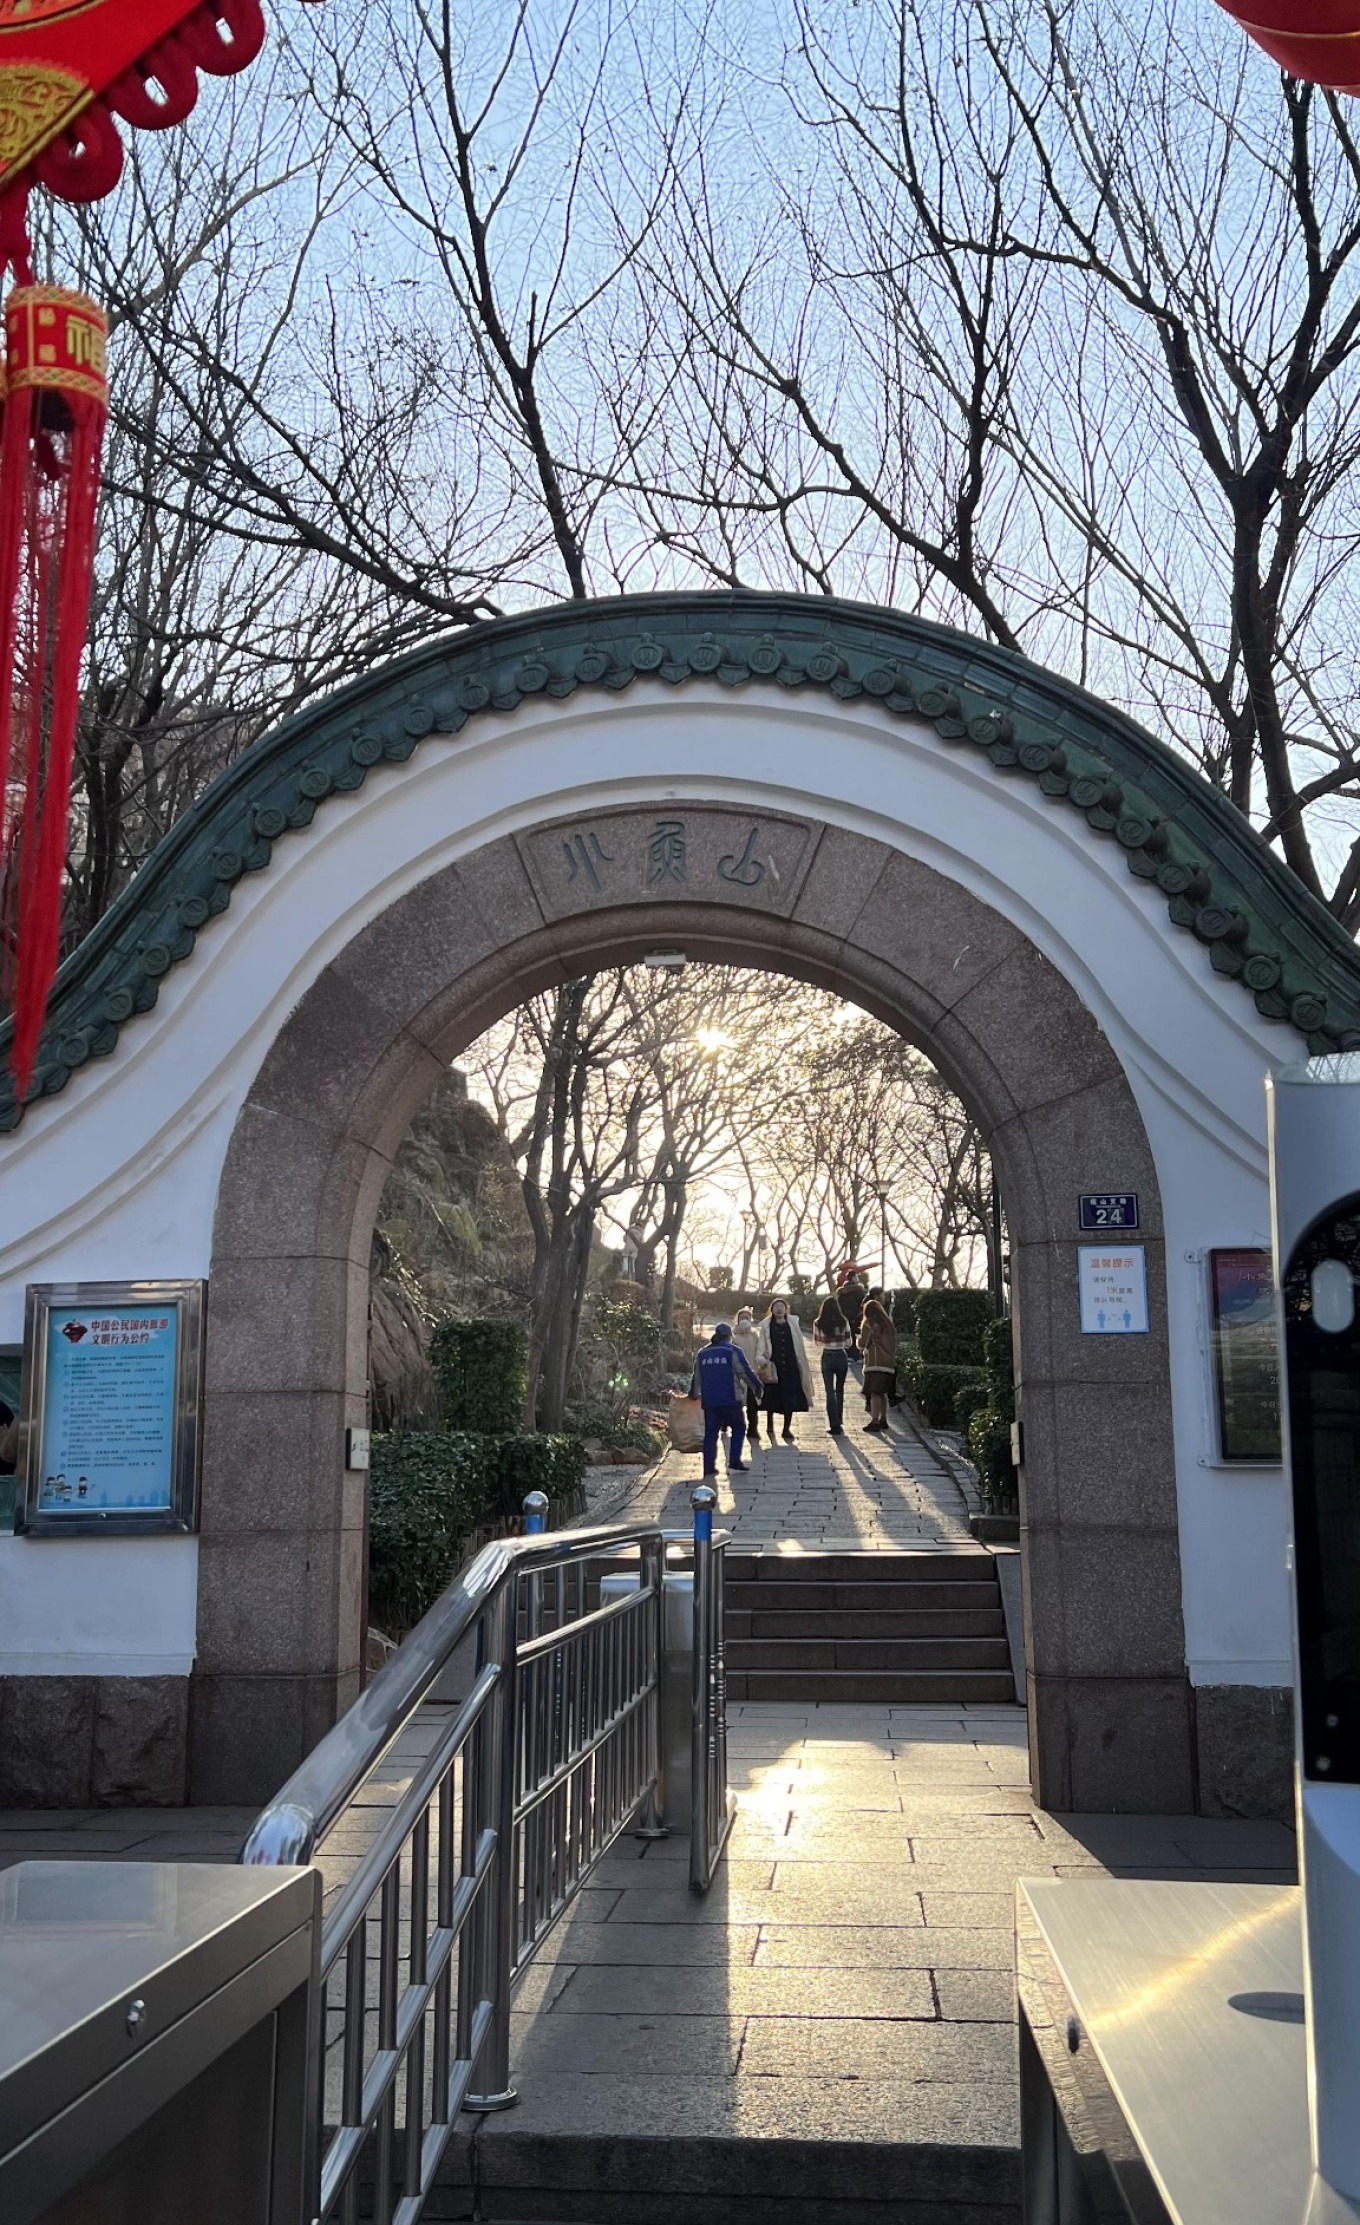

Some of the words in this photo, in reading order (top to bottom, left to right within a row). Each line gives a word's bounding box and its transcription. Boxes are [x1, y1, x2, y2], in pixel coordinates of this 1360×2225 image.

[1096, 1208, 1121, 1224] 24
[1090, 1258, 1134, 1269] 温馨提示
[91, 1318, 168, 1332] 中国公民国内旅游
[91, 1333, 149, 1345] 文明行为公约
